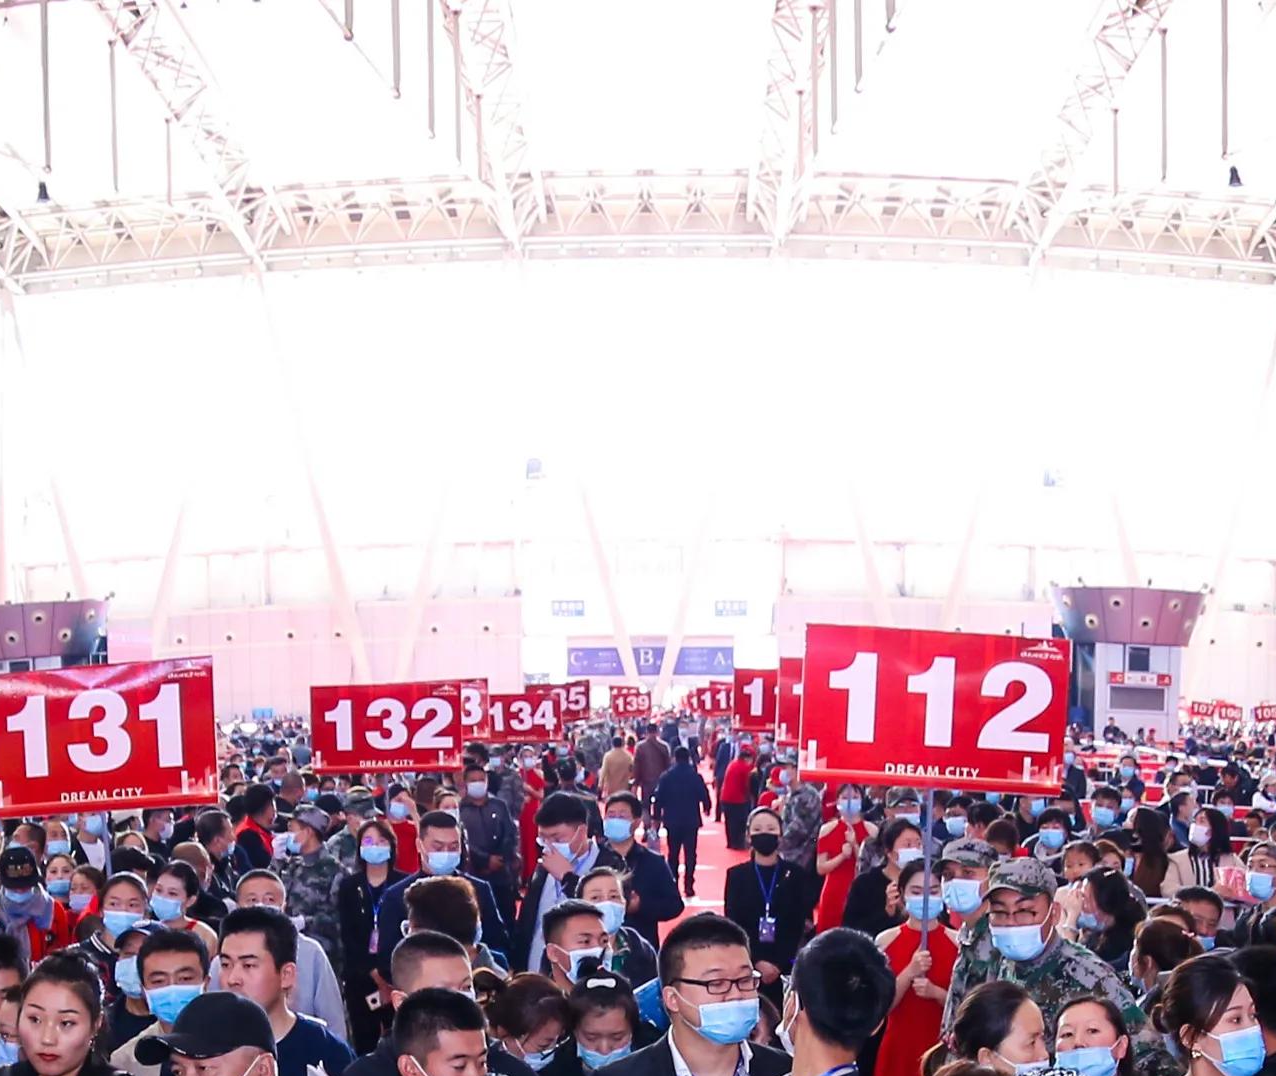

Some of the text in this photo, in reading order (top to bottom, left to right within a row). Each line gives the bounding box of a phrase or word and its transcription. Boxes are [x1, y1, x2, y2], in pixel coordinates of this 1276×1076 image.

[615, 694, 649, 712] 139
[829, 652, 1053, 753] 112
[324, 697, 454, 751] 132
[489, 700, 557, 731] 134
[6, 683, 183, 778] 131
[359, 760, 391, 768] DREAM
[885, 763, 979, 778] DREAM CITY
[60, 787, 143, 803] DREAM CITY
